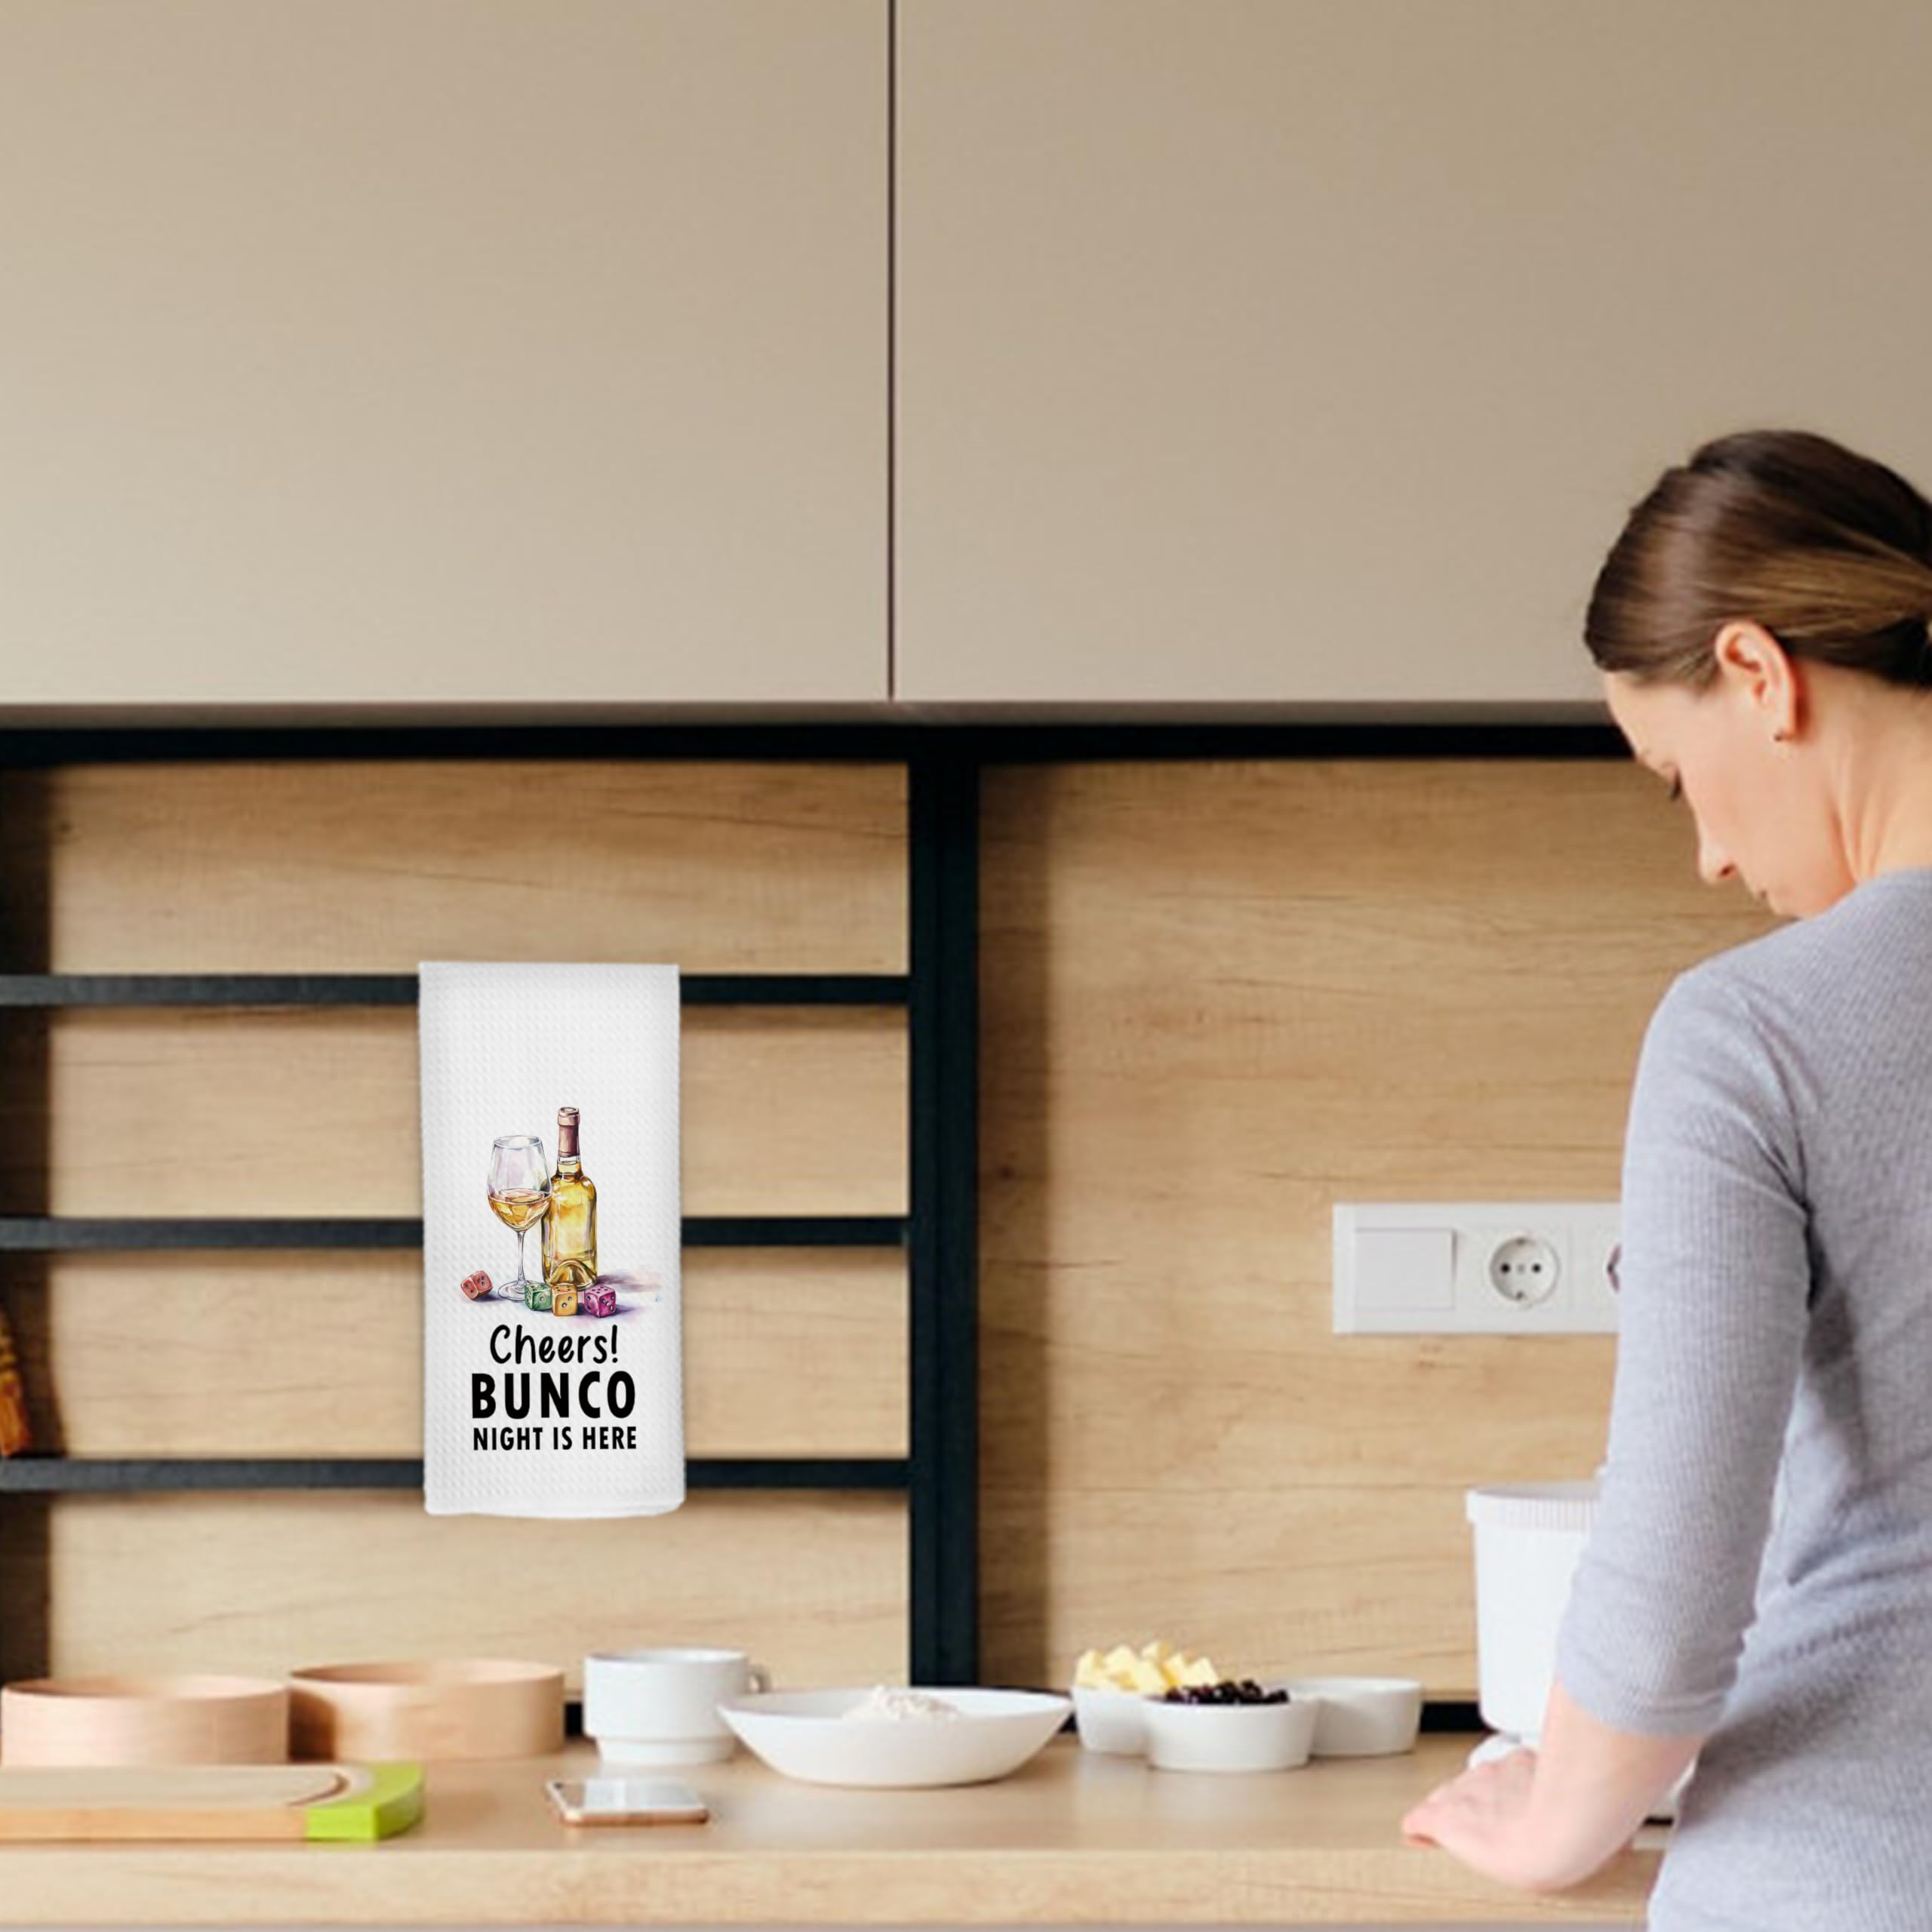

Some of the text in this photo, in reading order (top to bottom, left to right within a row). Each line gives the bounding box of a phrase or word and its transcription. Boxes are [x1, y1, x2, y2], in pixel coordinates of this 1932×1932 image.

[490, 1324, 618, 1364] Cheers!
[472, 1371, 635, 1420] BUNCO
[473, 1426, 637, 1451] NIGHT IS HERE
